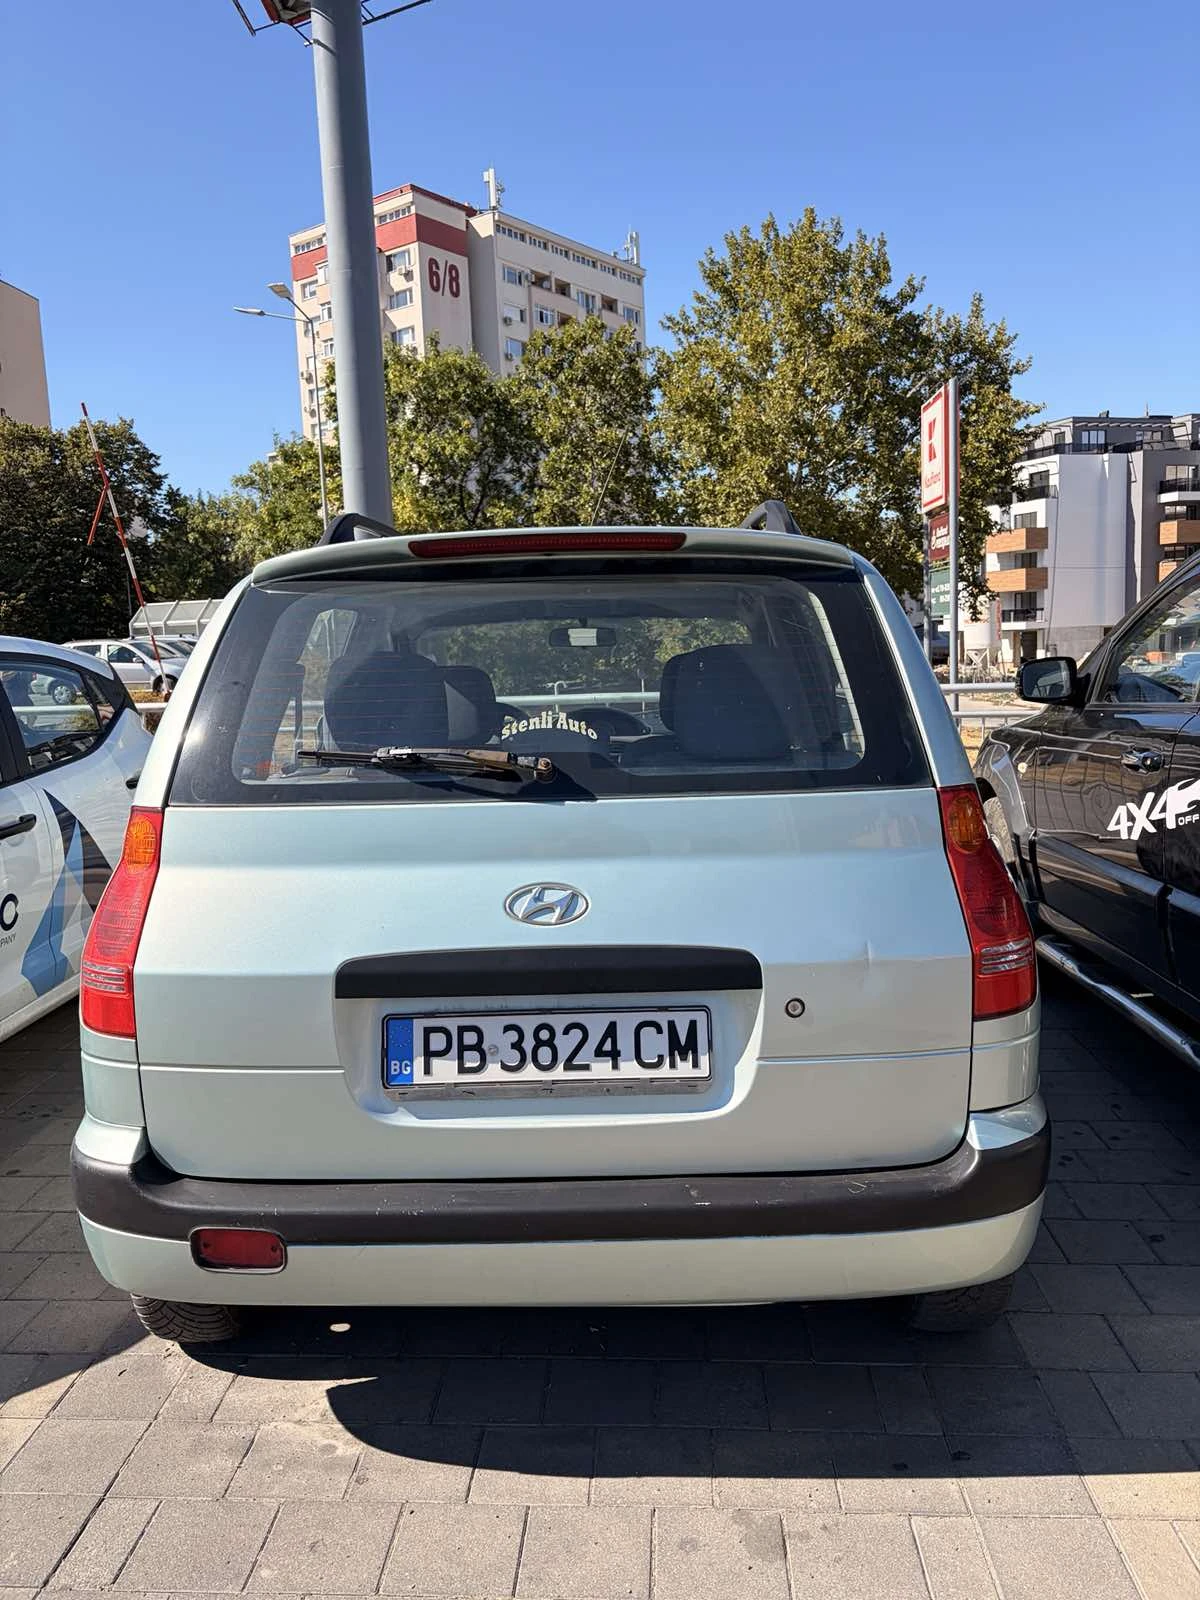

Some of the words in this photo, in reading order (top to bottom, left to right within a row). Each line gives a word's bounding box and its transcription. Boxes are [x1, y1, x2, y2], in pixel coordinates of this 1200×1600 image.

[428, 257, 461, 299] 6/8
[556, 712, 598, 740] Auto
[1178, 813, 1200, 826] OFF
[422, 1025, 488, 1075] PB
[500, 1020, 622, 1073] 3824
[633, 1019, 699, 1070] CM
[390, 1060, 411, 1075] BG
